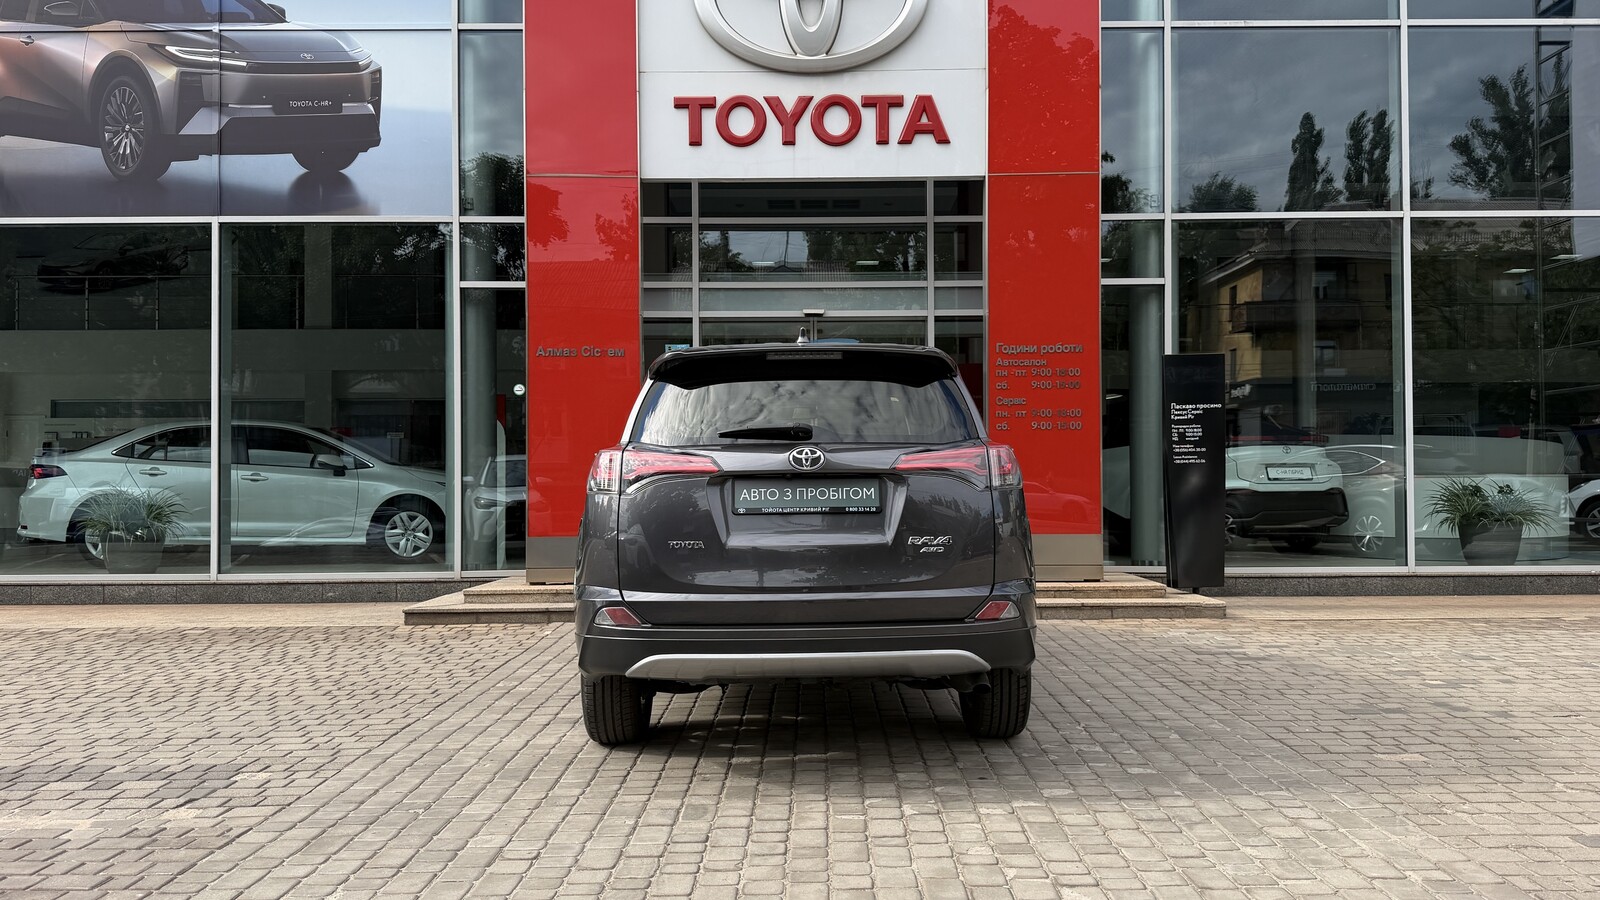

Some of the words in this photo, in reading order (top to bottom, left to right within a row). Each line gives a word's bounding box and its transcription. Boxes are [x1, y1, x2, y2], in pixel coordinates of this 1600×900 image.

[674, 94, 951, 147] TOYOTA
[536, 346, 577, 357] Алмаз
[581, 346, 624, 357] Сісем
[996, 342, 1038, 354] Години
[1040, 342, 1083, 355] роботи
[996, 358, 1046, 366] Автосалон
[740, 488, 780, 501] АВТО
[783, 488, 792, 500] З
[796, 488, 875, 500] ПРОБІГОМ
[668, 540, 704, 548] TOYOTA
[908, 536, 952, 545] RAV4
